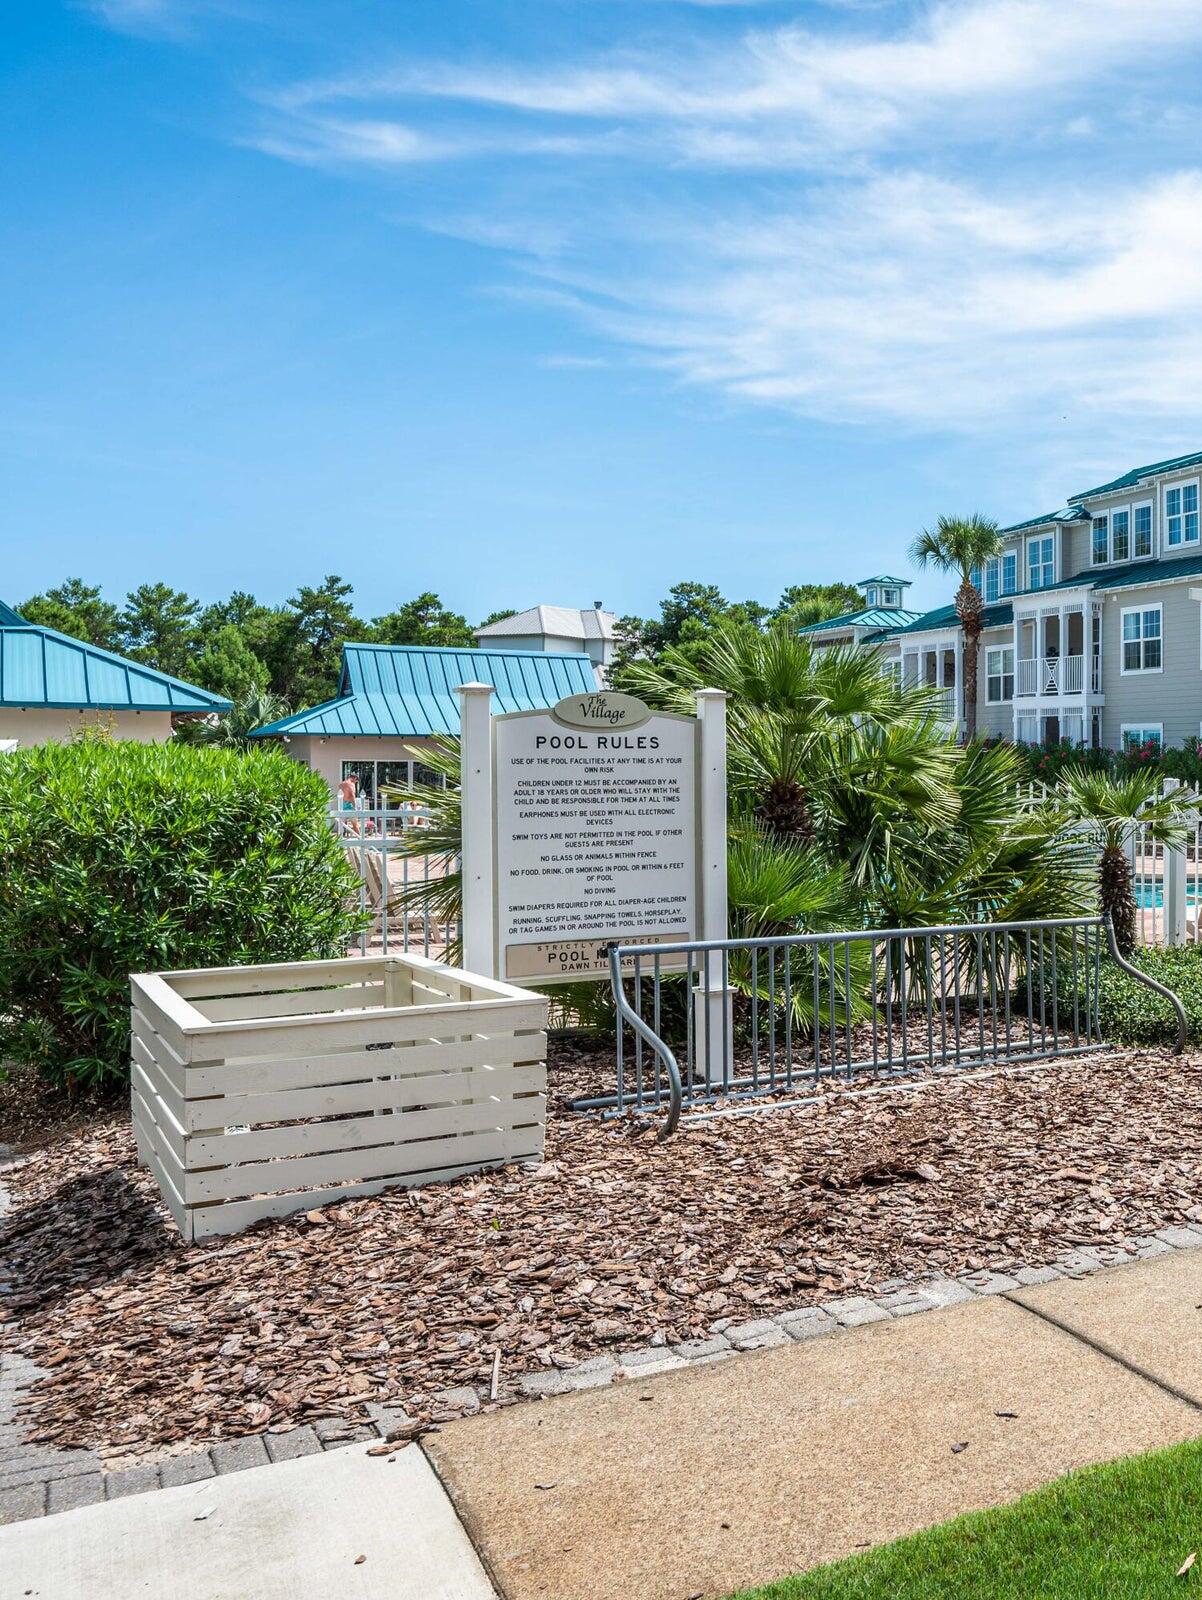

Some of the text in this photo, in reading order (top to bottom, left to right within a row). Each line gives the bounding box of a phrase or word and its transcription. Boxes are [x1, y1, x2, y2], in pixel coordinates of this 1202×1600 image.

[587, 694, 607, 707] The
[579, 703, 626, 724] Village
[536, 736, 660, 750] POOL RULES
[527, 903, 555, 911] DIAPERS
[557, 901, 589, 910] REQUIRED
[618, 898, 656, 906] DIAPER-AGE
[657, 896, 687, 904] CHILDREN
[584, 913, 616, 921] SNAPPING
[535, 925, 558, 933] GAMES
[578, 922, 604, 930] AROUND
[658, 917, 687, 926] ALLOWED
[537, 942, 594, 952] STRICTLY
[548, 950, 590, 964] POOL
[561, 962, 590, 971] DAWN
